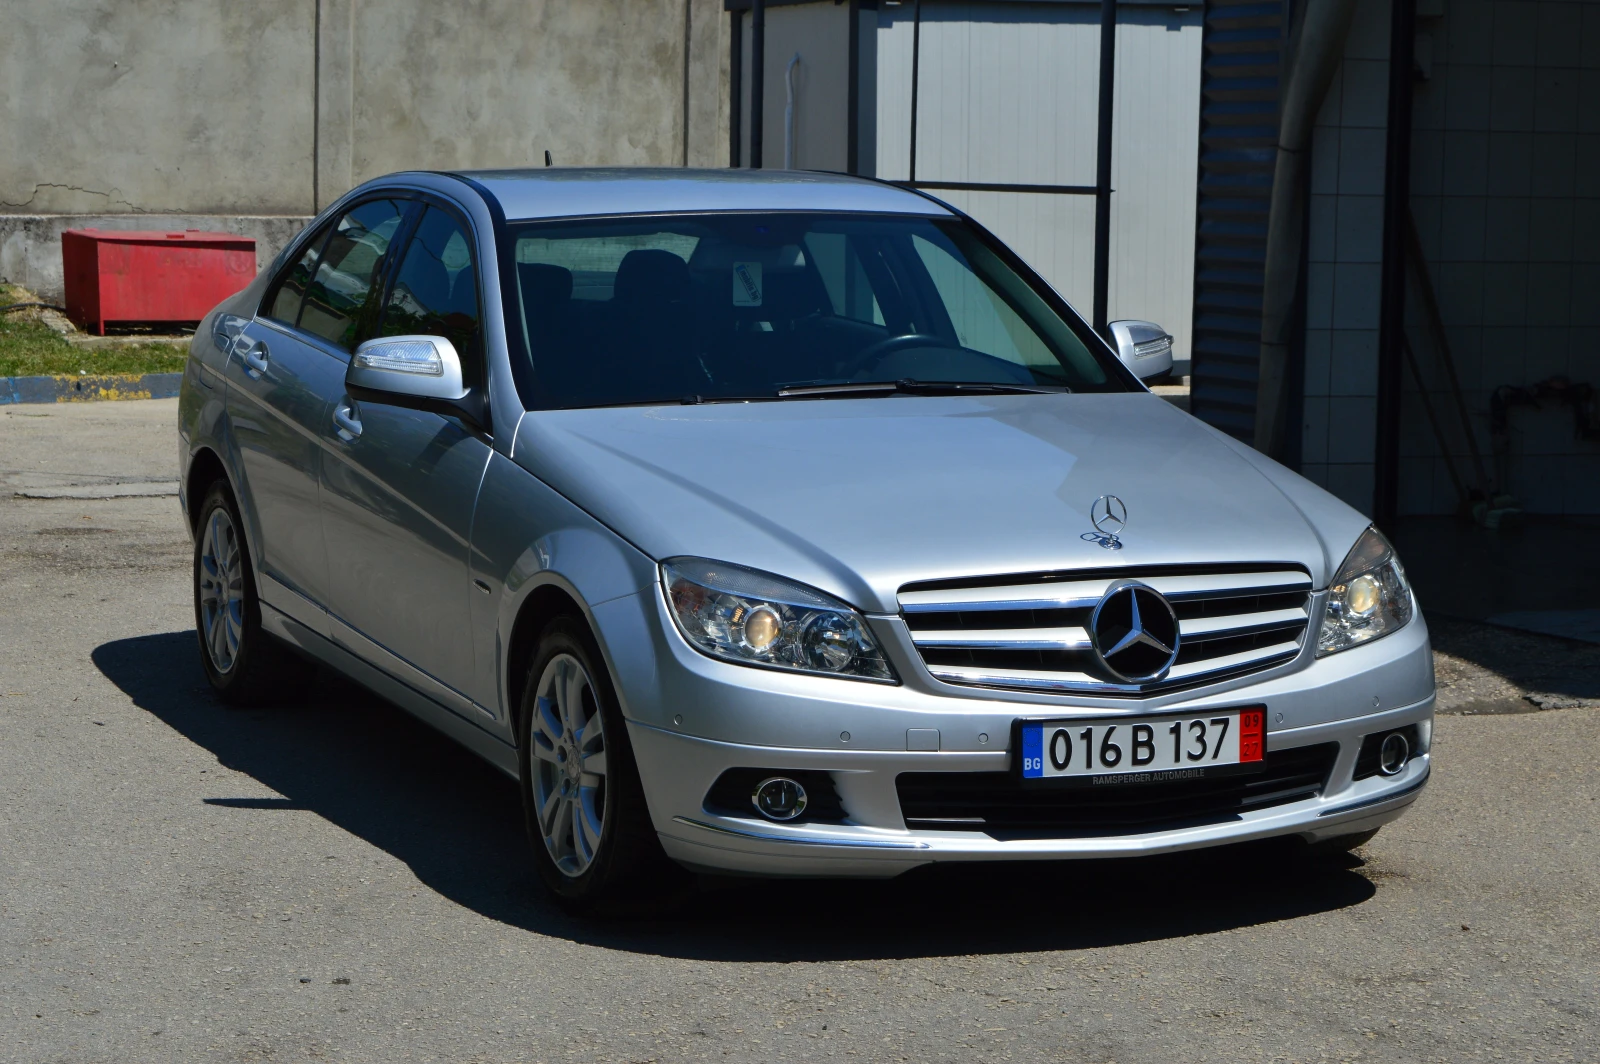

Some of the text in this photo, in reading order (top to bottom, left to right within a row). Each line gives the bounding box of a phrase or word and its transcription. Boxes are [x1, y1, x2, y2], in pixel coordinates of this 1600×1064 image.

[1244, 714, 1259, 727] 09
[1243, 742, 1258, 756] 27
[1024, 757, 1041, 770] BG
[1092, 768, 1205, 785] RAMSPERGER AUTOMOBILE
